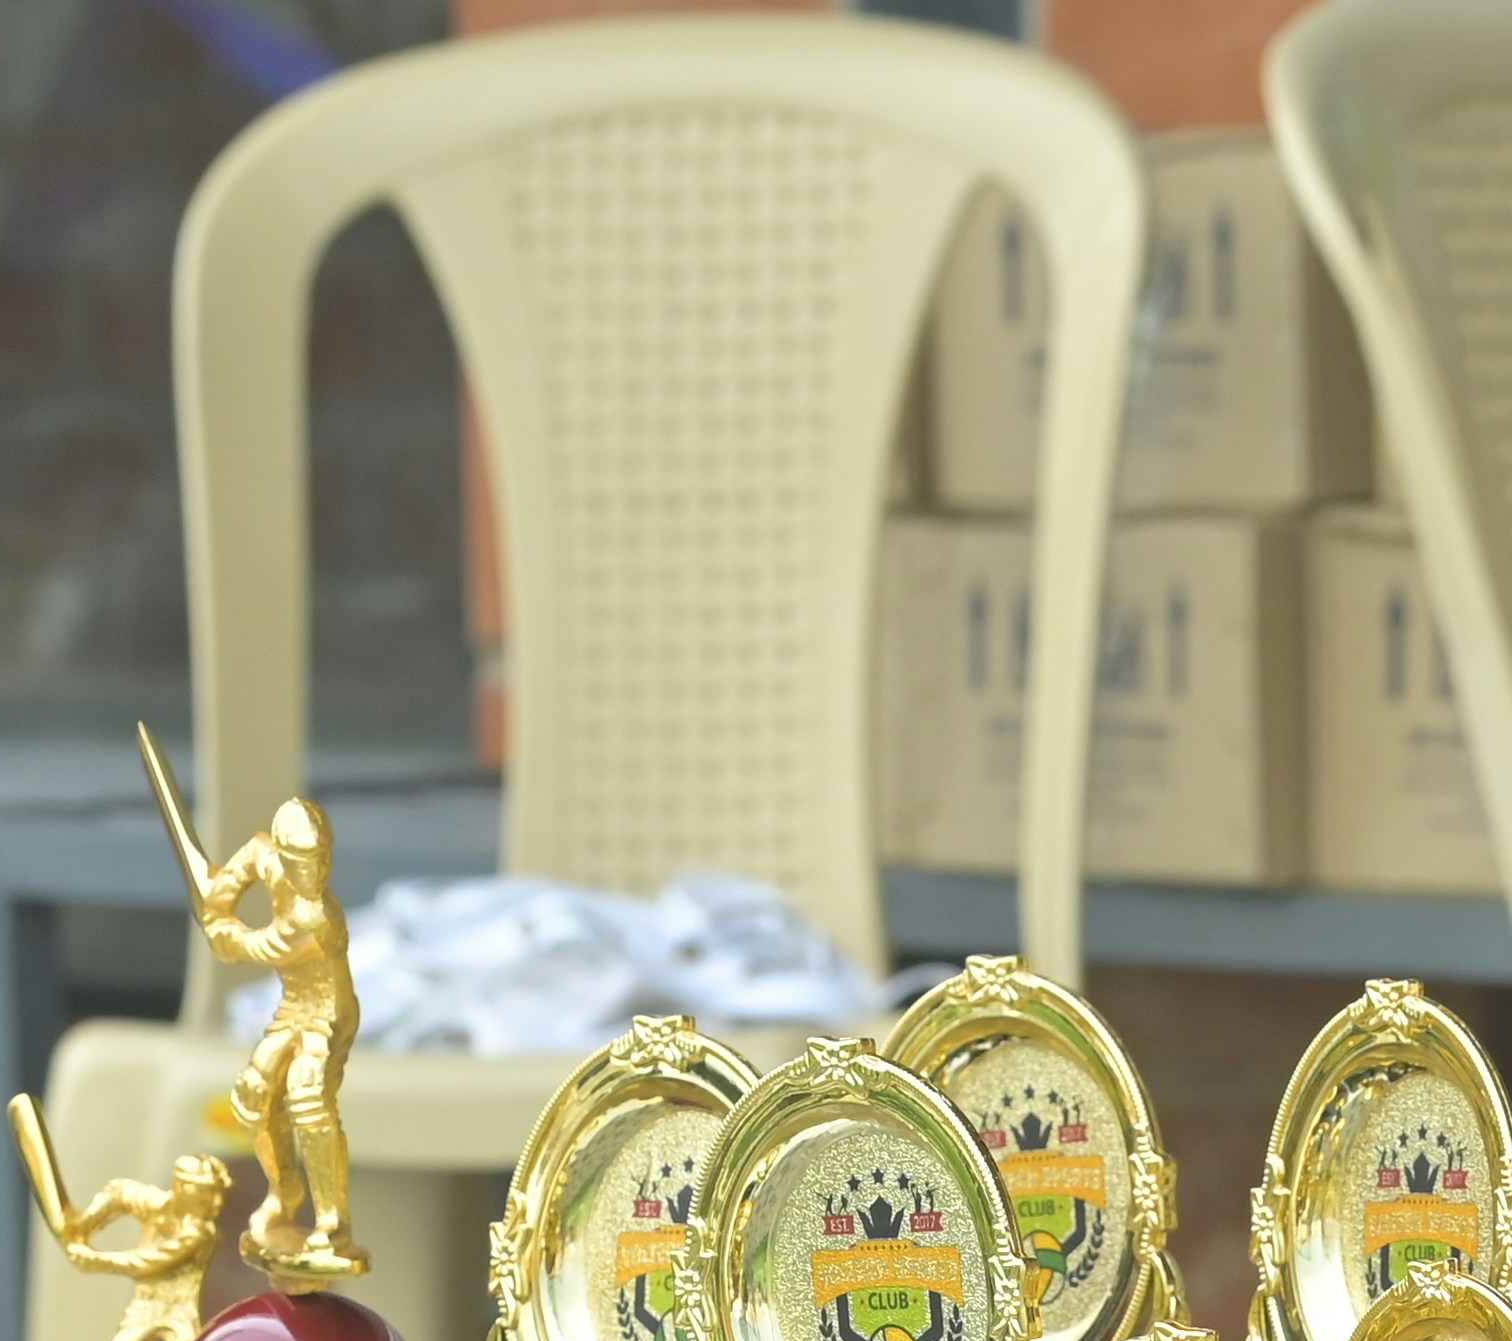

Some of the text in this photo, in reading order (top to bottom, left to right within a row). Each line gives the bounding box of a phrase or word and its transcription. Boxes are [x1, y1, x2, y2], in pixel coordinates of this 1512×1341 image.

[1018, 1199, 1054, 1216] CLUB
[829, 1219, 850, 1233] EST.
[913, 1215, 936, 1230] 2017
[1404, 1244, 1436, 1260] CLUB
[868, 1291, 910, 1311] CLUB
